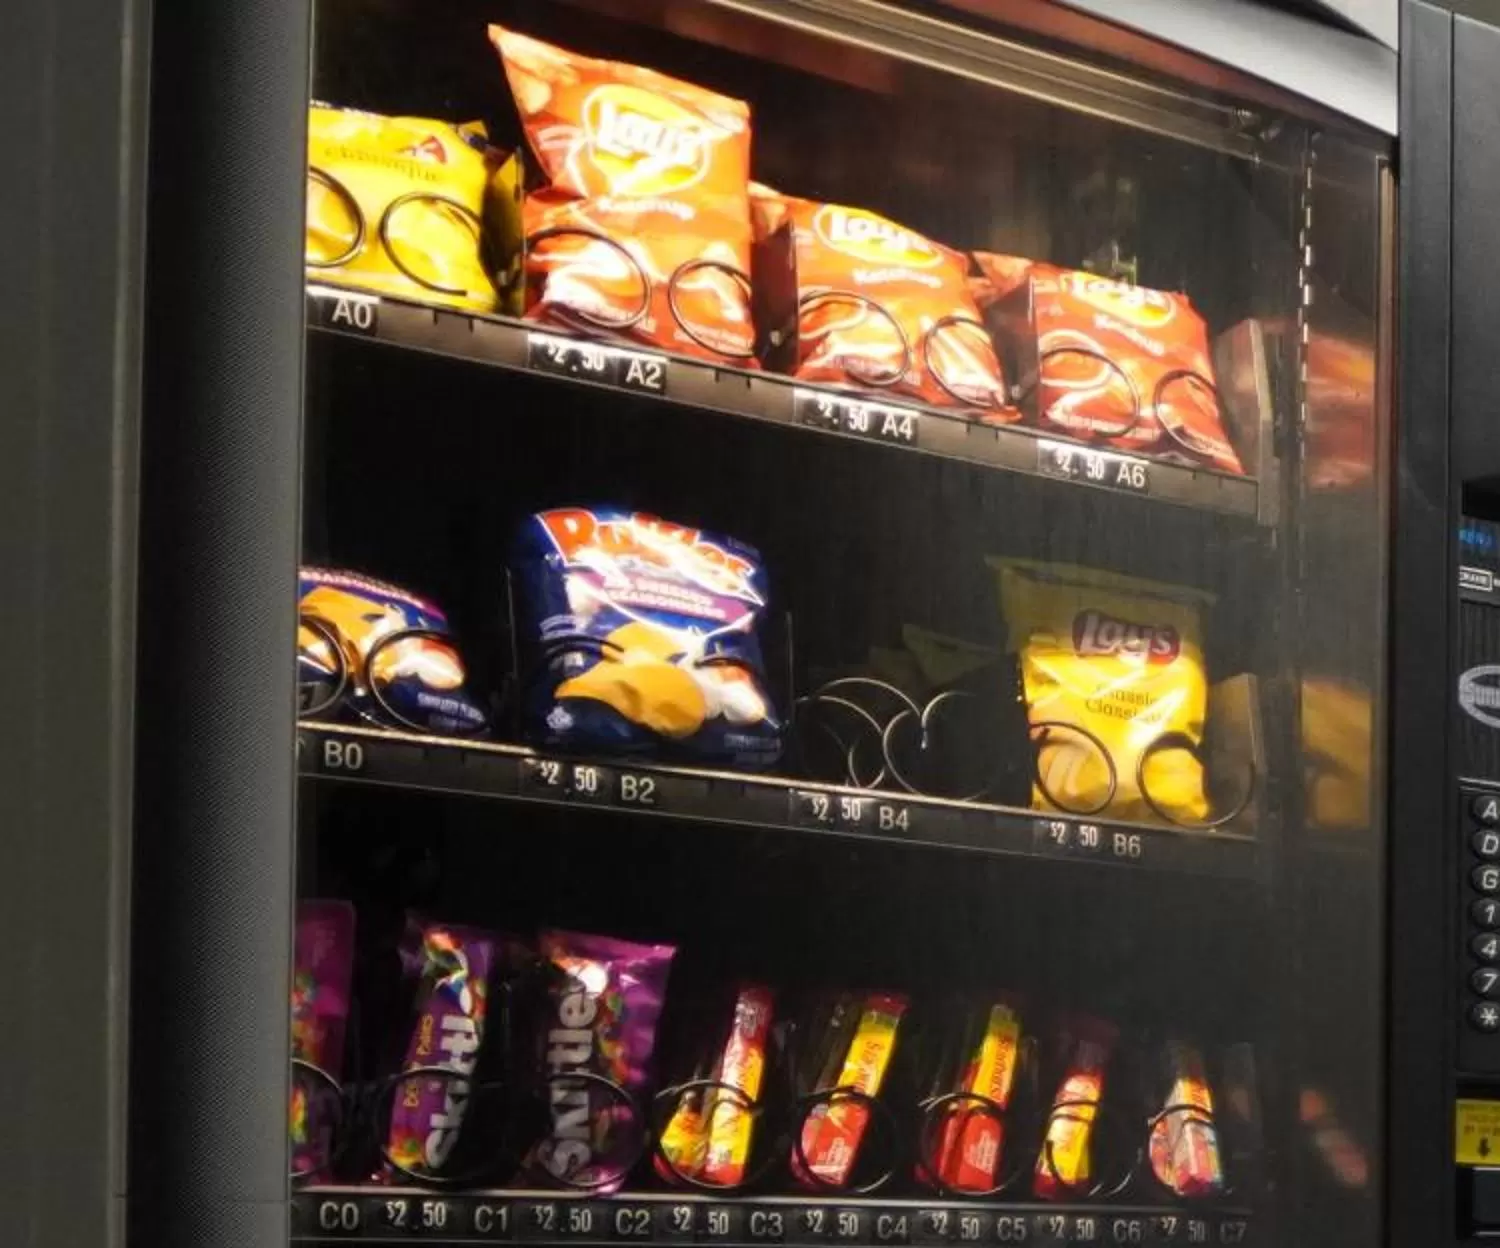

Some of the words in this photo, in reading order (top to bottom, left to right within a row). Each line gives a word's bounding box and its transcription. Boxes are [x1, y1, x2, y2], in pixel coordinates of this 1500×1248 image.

[332, 299, 372, 331] A0
[626, 361, 662, 389] A2
[881, 412, 913, 440] A4
[1117, 461, 1146, 489] A6
[324, 740, 364, 770] B0
[620, 775, 655, 803] B2
[879, 807, 911, 831] B4
[1482, 801, 1498, 820] A
[1113, 832, 1141, 857] B6
[1481, 835, 1499, 855] D
[1482, 869, 1499, 890] G
[1485, 904, 1496, 923] 1
[1481, 940, 1498, 959] 4
[1482, 973, 1498, 993] 7
[541, 981, 598, 1179] Skittle
[319, 1201, 360, 1231] C0
[474, 1205, 508, 1232] C1
[615, 1208, 650, 1235] C2
[750, 1211, 785, 1236] C3
[877, 1214, 908, 1239] C4
[997, 1216, 1026, 1241] C5
[1113, 1219, 1142, 1243] C6
